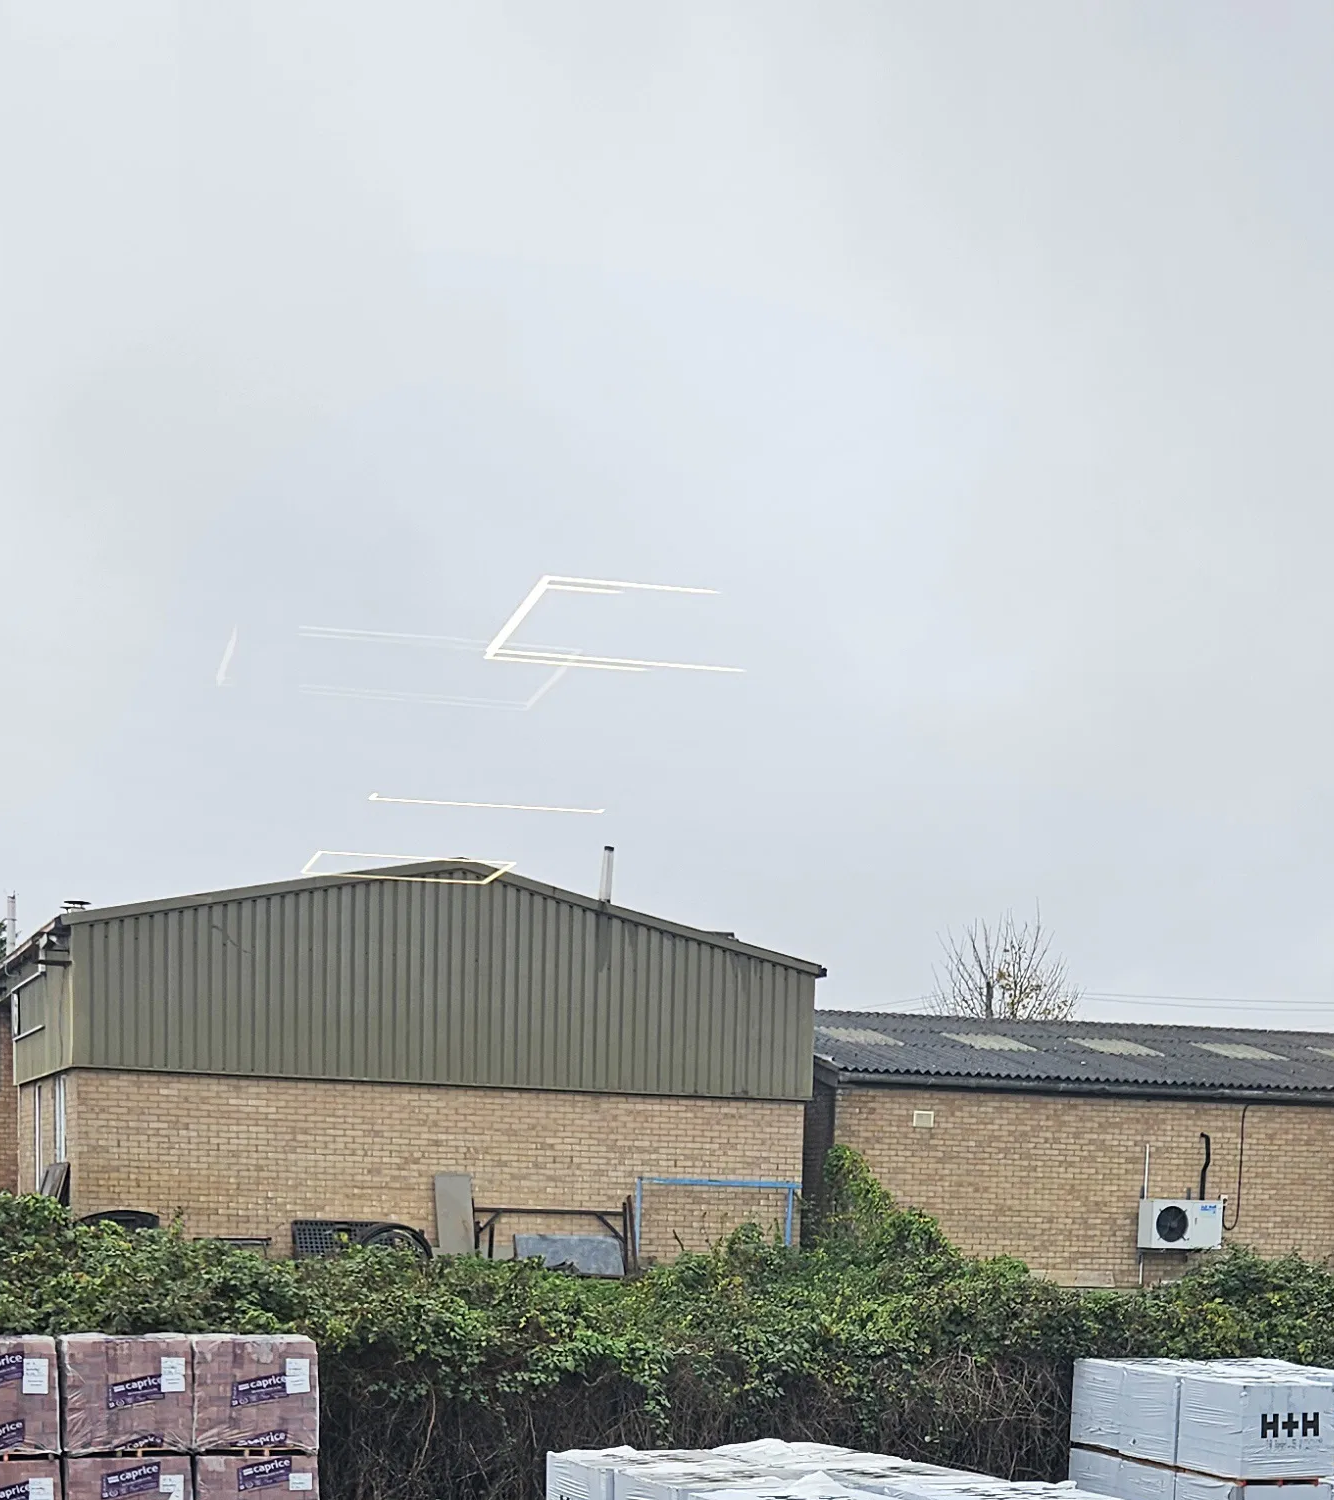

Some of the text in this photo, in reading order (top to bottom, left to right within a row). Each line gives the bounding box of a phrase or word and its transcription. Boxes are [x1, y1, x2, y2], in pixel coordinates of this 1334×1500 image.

[1261, 1412, 1319, 1438] H+H
[119, 1464, 159, 1482] caprice
[253, 1458, 291, 1474] caprice
